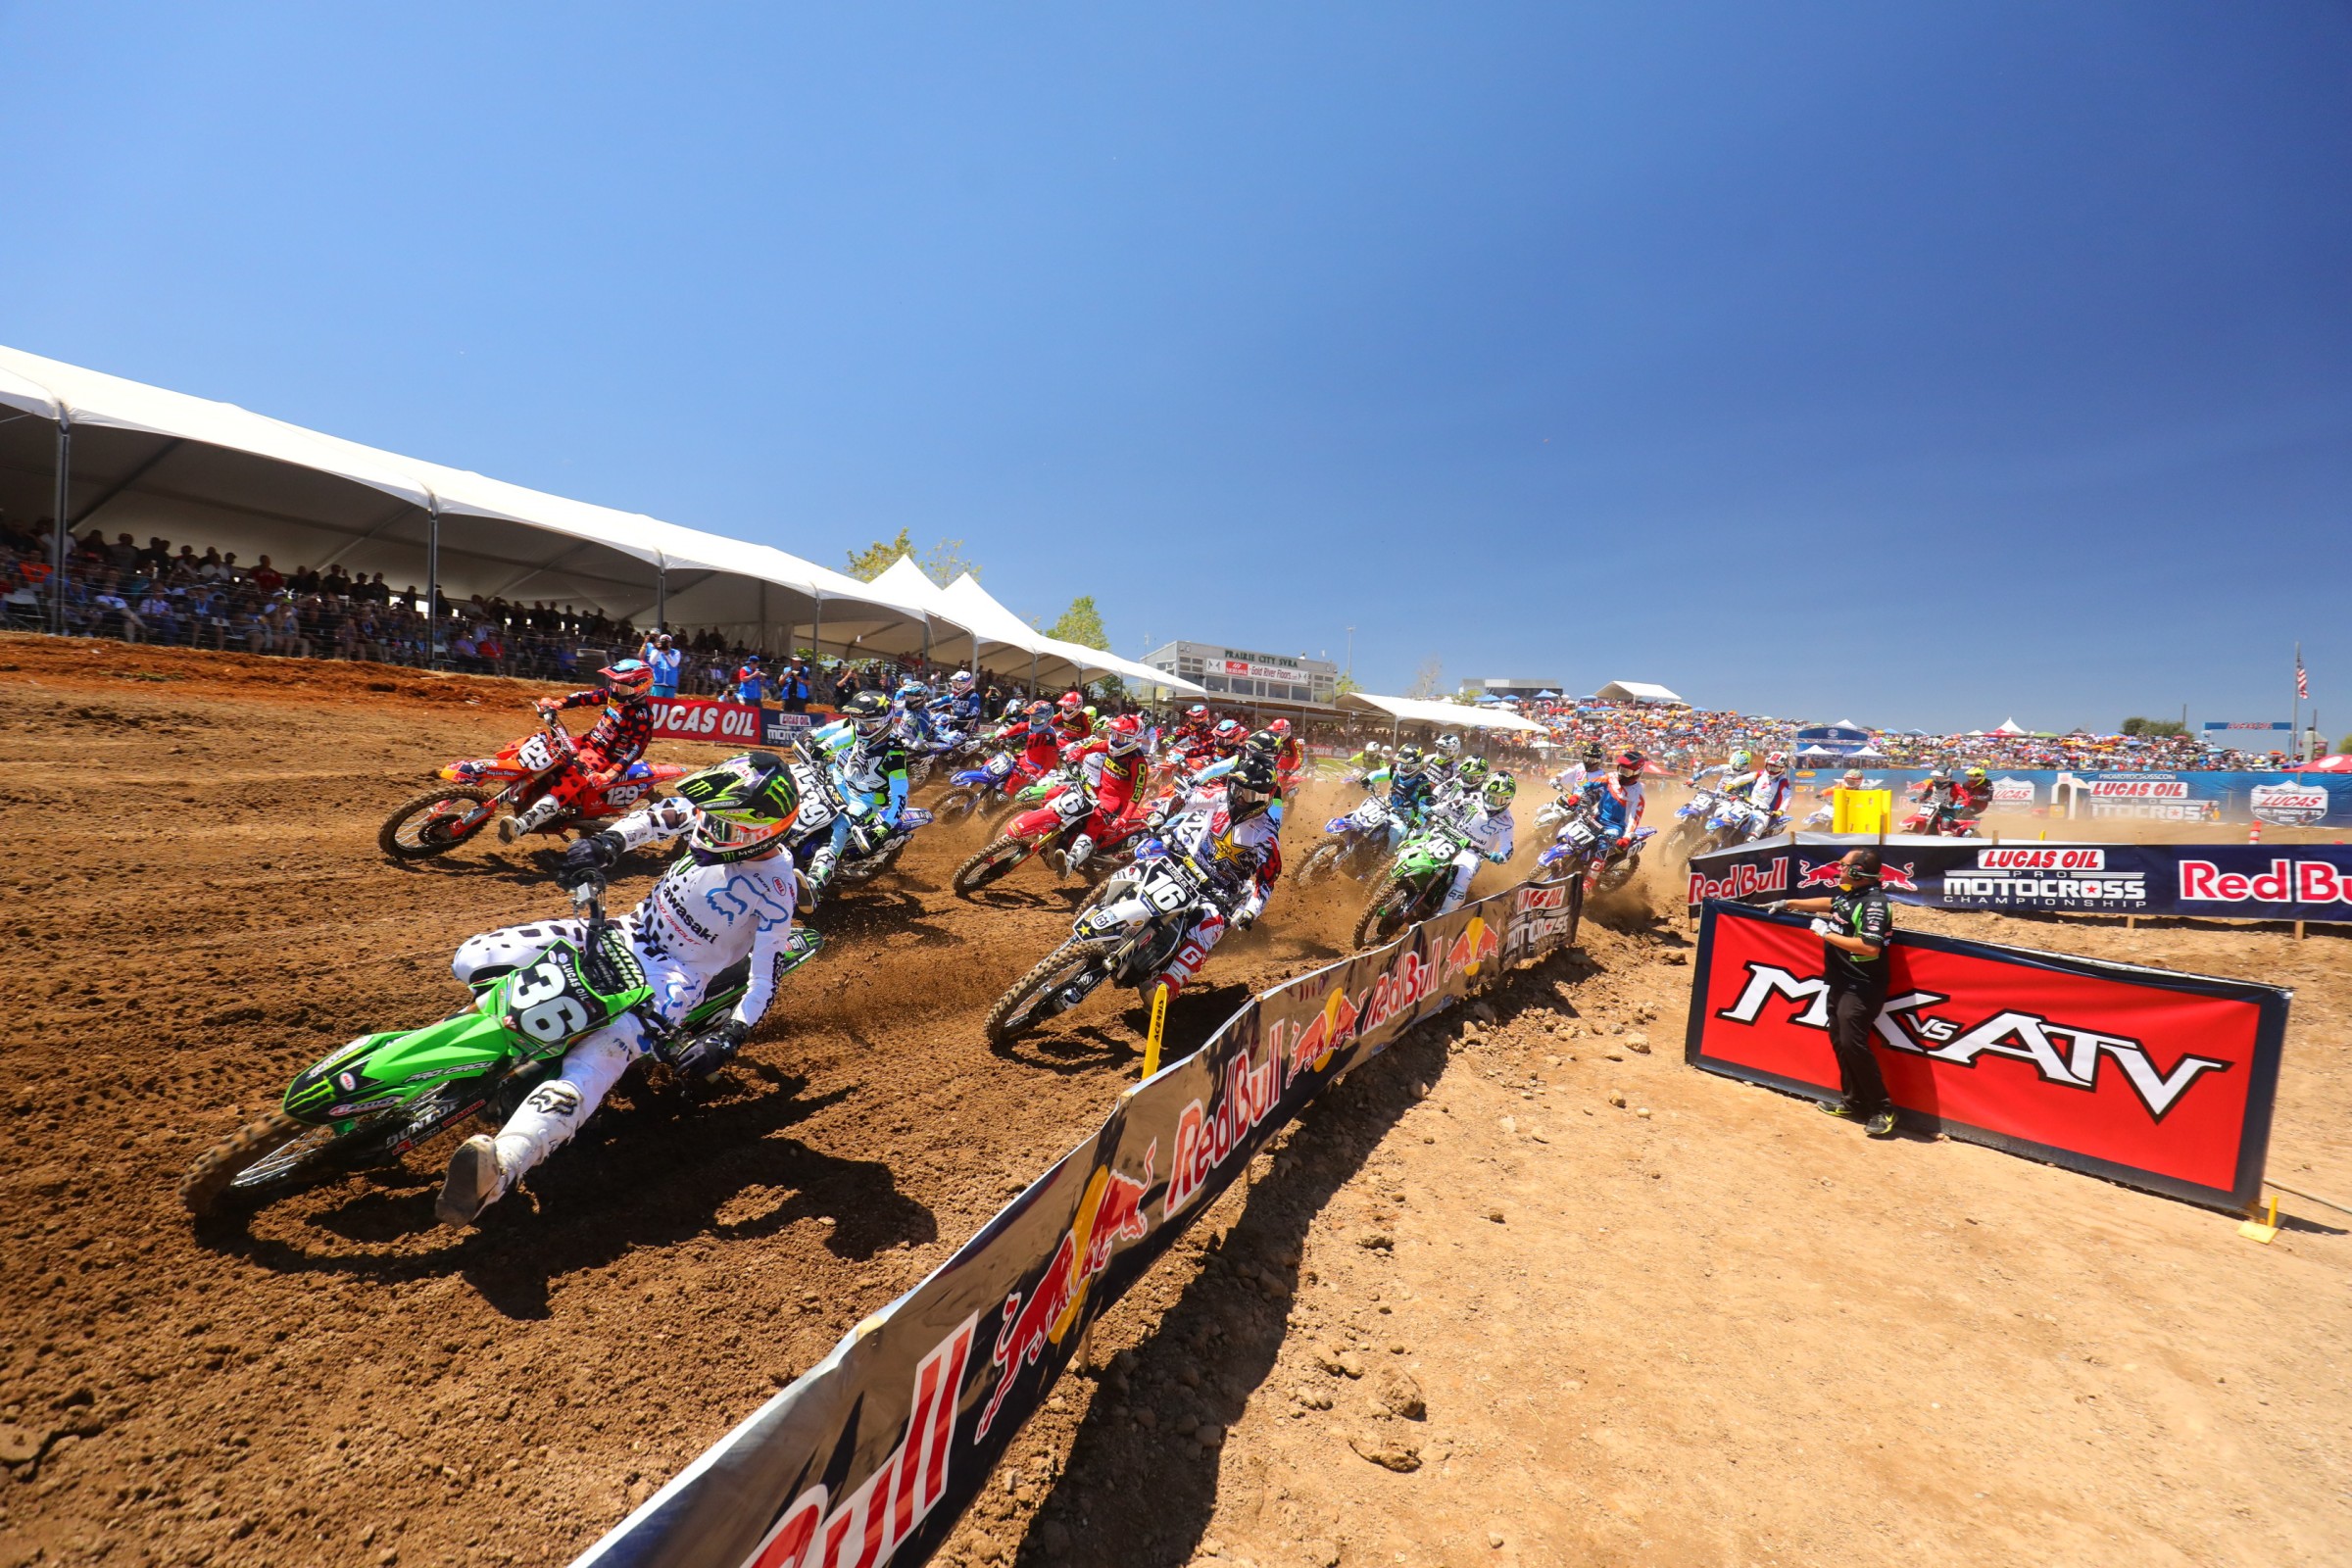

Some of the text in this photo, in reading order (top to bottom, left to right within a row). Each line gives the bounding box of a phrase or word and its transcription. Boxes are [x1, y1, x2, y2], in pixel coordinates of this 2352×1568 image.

[1225, 650, 1255, 662] PRAIRIE
[1258, 655, 1276, 664] CITY
[1250, 665, 1262, 675] Gold
[1262, 667, 1277, 677] River
[653, 703, 717, 734] UCAS
[721, 710, 757, 736] OIL
[782, 714, 809, 725] LUCAS OIL
[2227, 721, 2273, 730] LUCAS OIL
[518, 736, 555, 771] 129
[608, 785, 639, 806] 129
[1131, 763, 1147, 803] GEICO
[1993, 790, 2031, 799] UCAS
[2090, 782, 2183, 797] LUCAS OIL
[799, 790, 831, 825] 39
[1059, 791, 1083, 814] 6
[2261, 796, 2323, 808] LUCAS
[1127, 835, 1139, 848] 6
[1425, 837, 1456, 861] 46
[1984, 850, 2099, 868] LUCAS OIL
[774, 878, 785, 894] BELL
[1143, 870, 1187, 911] 16
[1688, 857, 1788, 906] Red Bull
[1943, 877, 2146, 899] MOTOCROSS
[2179, 859, 2292, 903] Red
[1545, 886, 1566, 907] OIL
[1943, 896, 2146, 907] CHAMPIONSHIP
[663, 886, 719, 944] awasaki
[664, 914, 702, 946] CIRCUIT
[1507, 916, 1569, 951] MOTCROSS
[562, 963, 590, 1002] LUCAS OIL
[1361, 953, 1403, 1036] Red
[1402, 935, 1443, 1010] Bull
[511, 962, 588, 1043] 36
[1154, 1000, 1164, 1043] ACERBIS
[1941, 1010, 2230, 1116] ATV
[342, 1073, 355, 1090] BELL
[1163, 1018, 1285, 1222] Red Bull
[740, 1309, 979, 1568] ull
